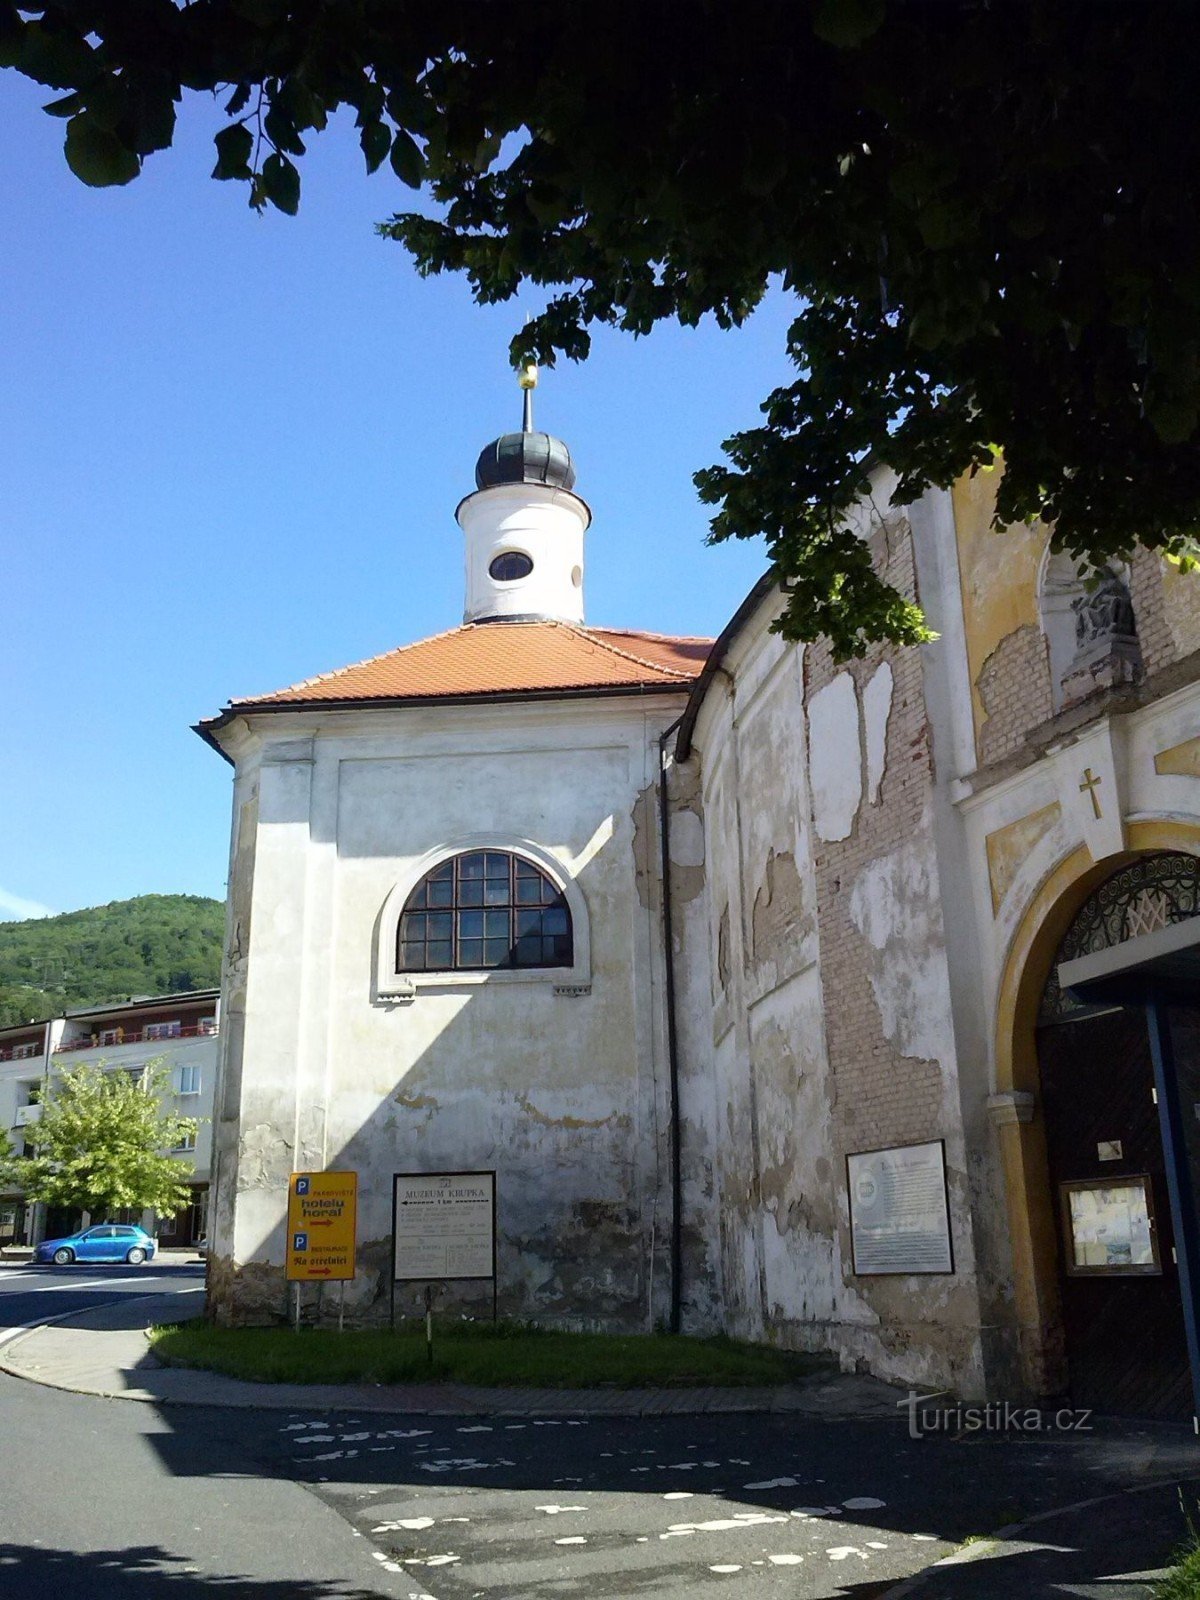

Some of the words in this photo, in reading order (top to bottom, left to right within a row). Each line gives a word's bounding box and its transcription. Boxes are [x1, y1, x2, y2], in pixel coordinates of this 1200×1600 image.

[298, 1181, 307, 1193] P
[405, 1190, 444, 1199] MUZEUM
[448, 1189, 485, 1198] KRUPKA
[301, 1199, 344, 1208] hotelu
[302, 1208, 342, 1217] horal
[296, 1236, 304, 1248] P
